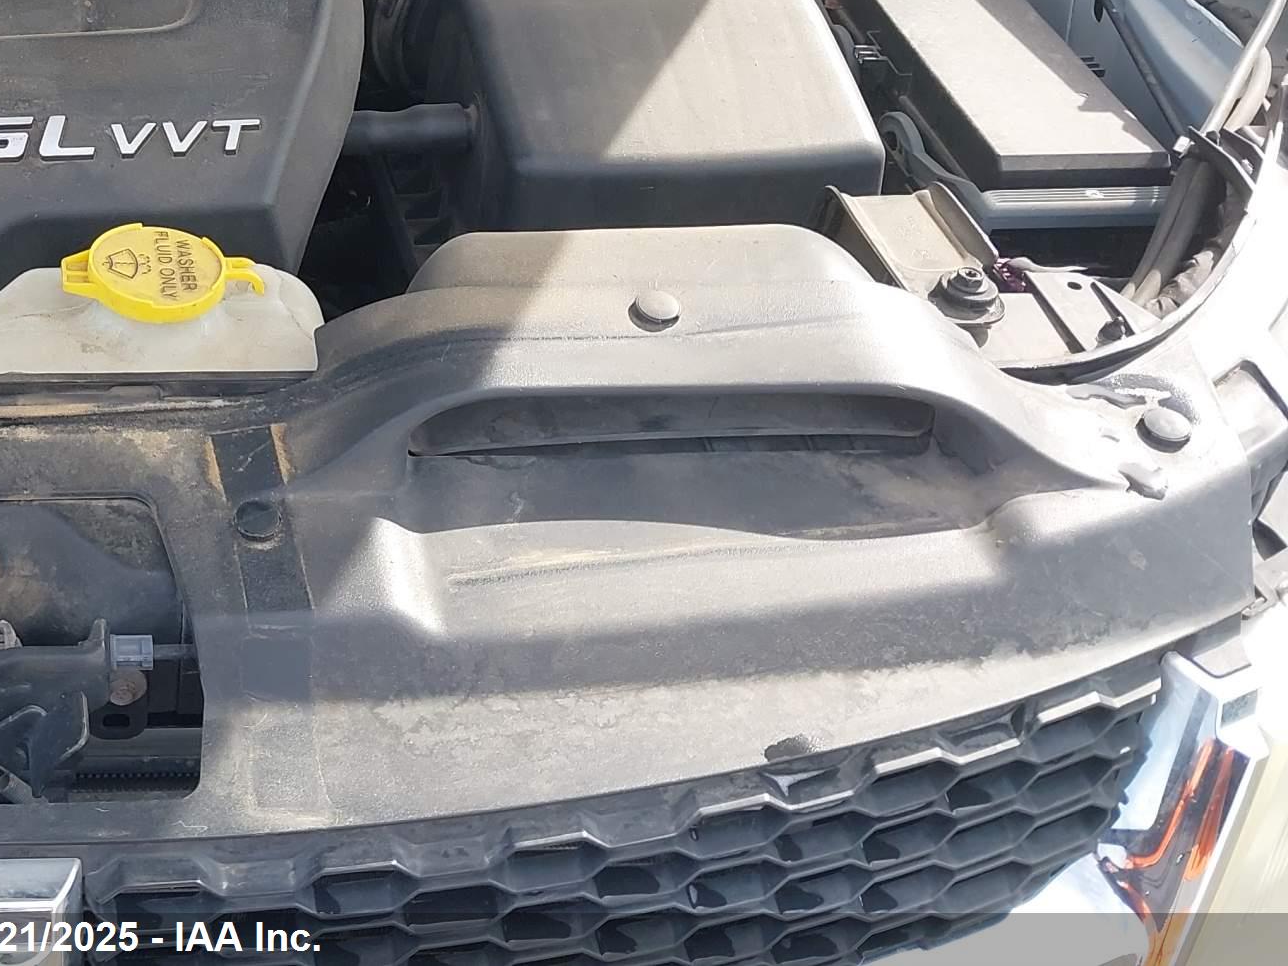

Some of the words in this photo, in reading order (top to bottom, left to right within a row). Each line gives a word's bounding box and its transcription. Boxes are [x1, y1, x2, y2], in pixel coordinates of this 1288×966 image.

[110, 117, 263, 160] VVT
[153, 230, 173, 265] FLUID
[176, 239, 198, 292] WASHER
[159, 267, 178, 300] ONLY
